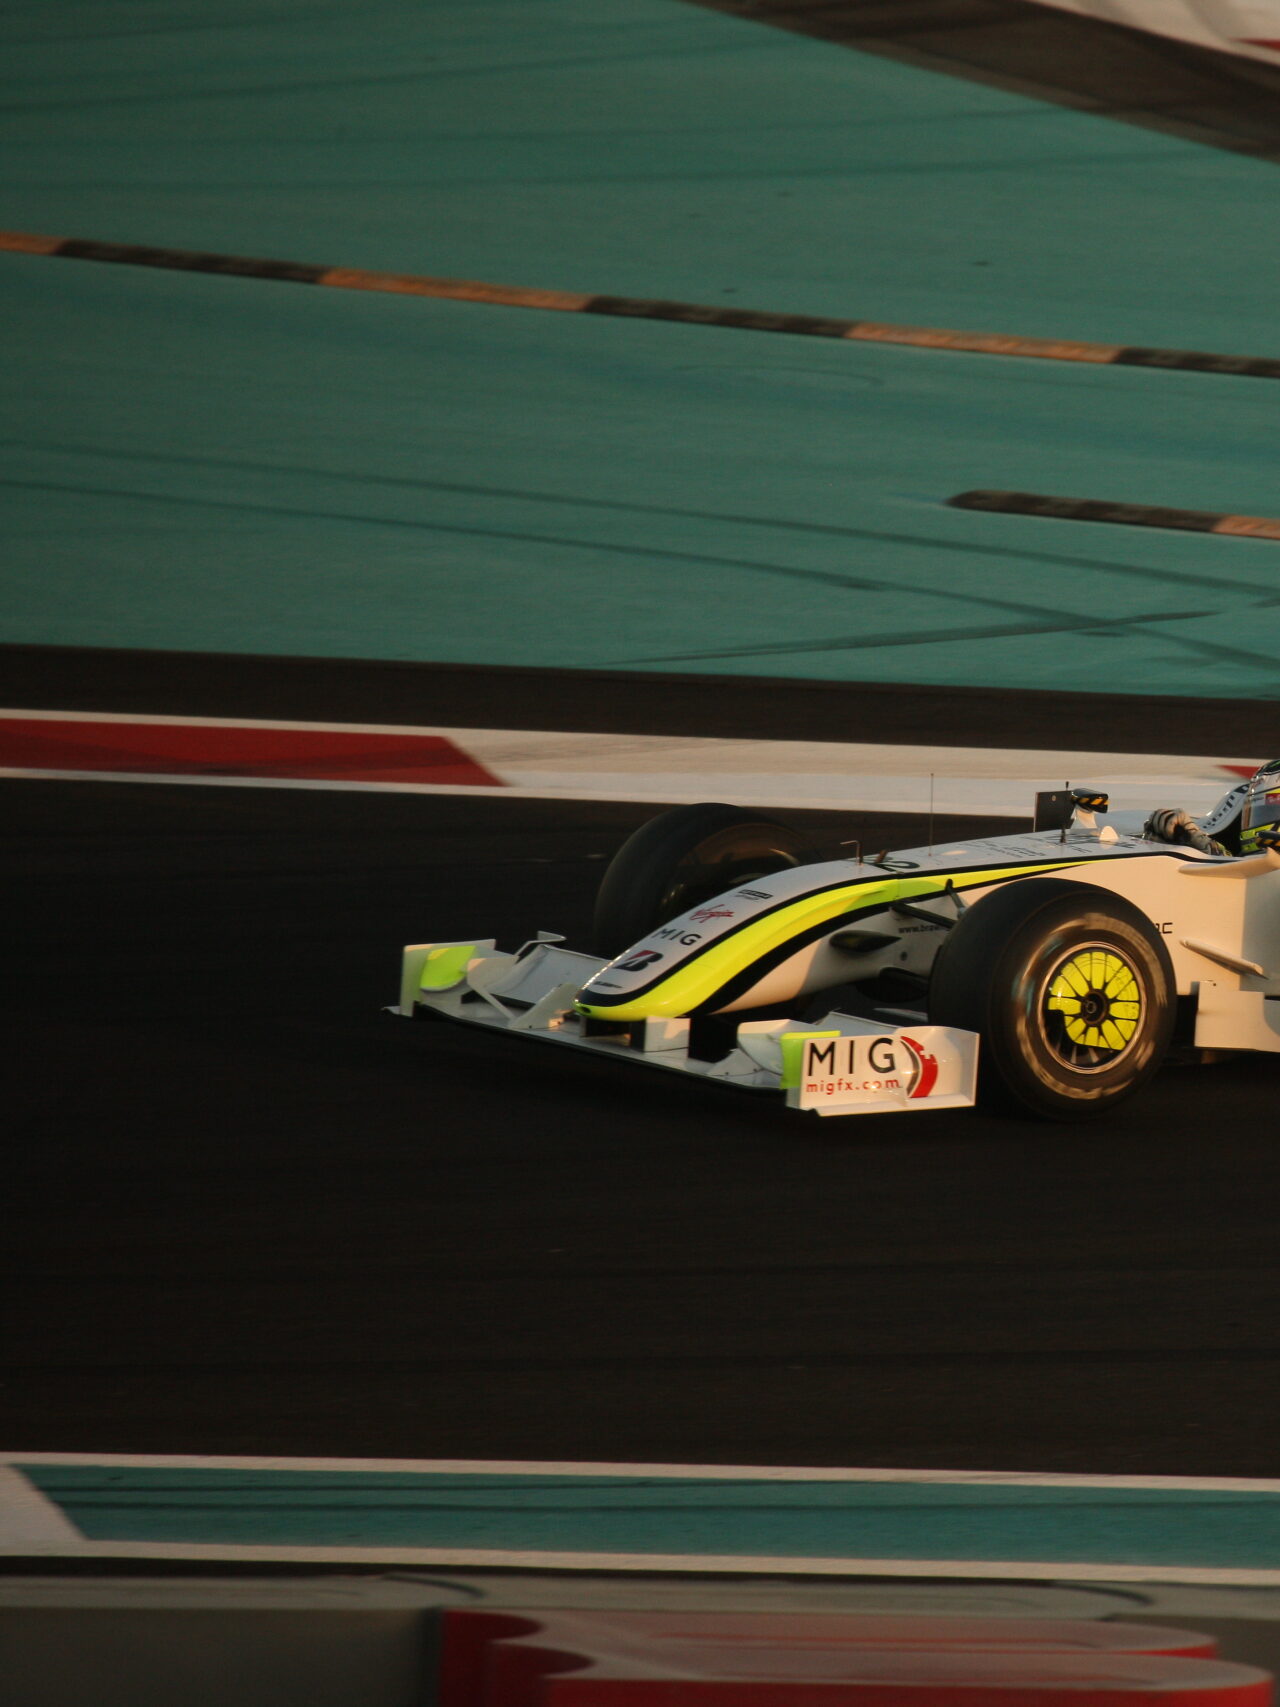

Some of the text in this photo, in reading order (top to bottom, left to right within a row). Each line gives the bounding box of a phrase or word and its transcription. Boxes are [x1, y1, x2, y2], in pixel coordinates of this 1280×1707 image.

[652, 928, 702, 946] MIG
[808, 1037, 896, 1077] MIG
[805, 1077, 900, 1095] migfx.com
